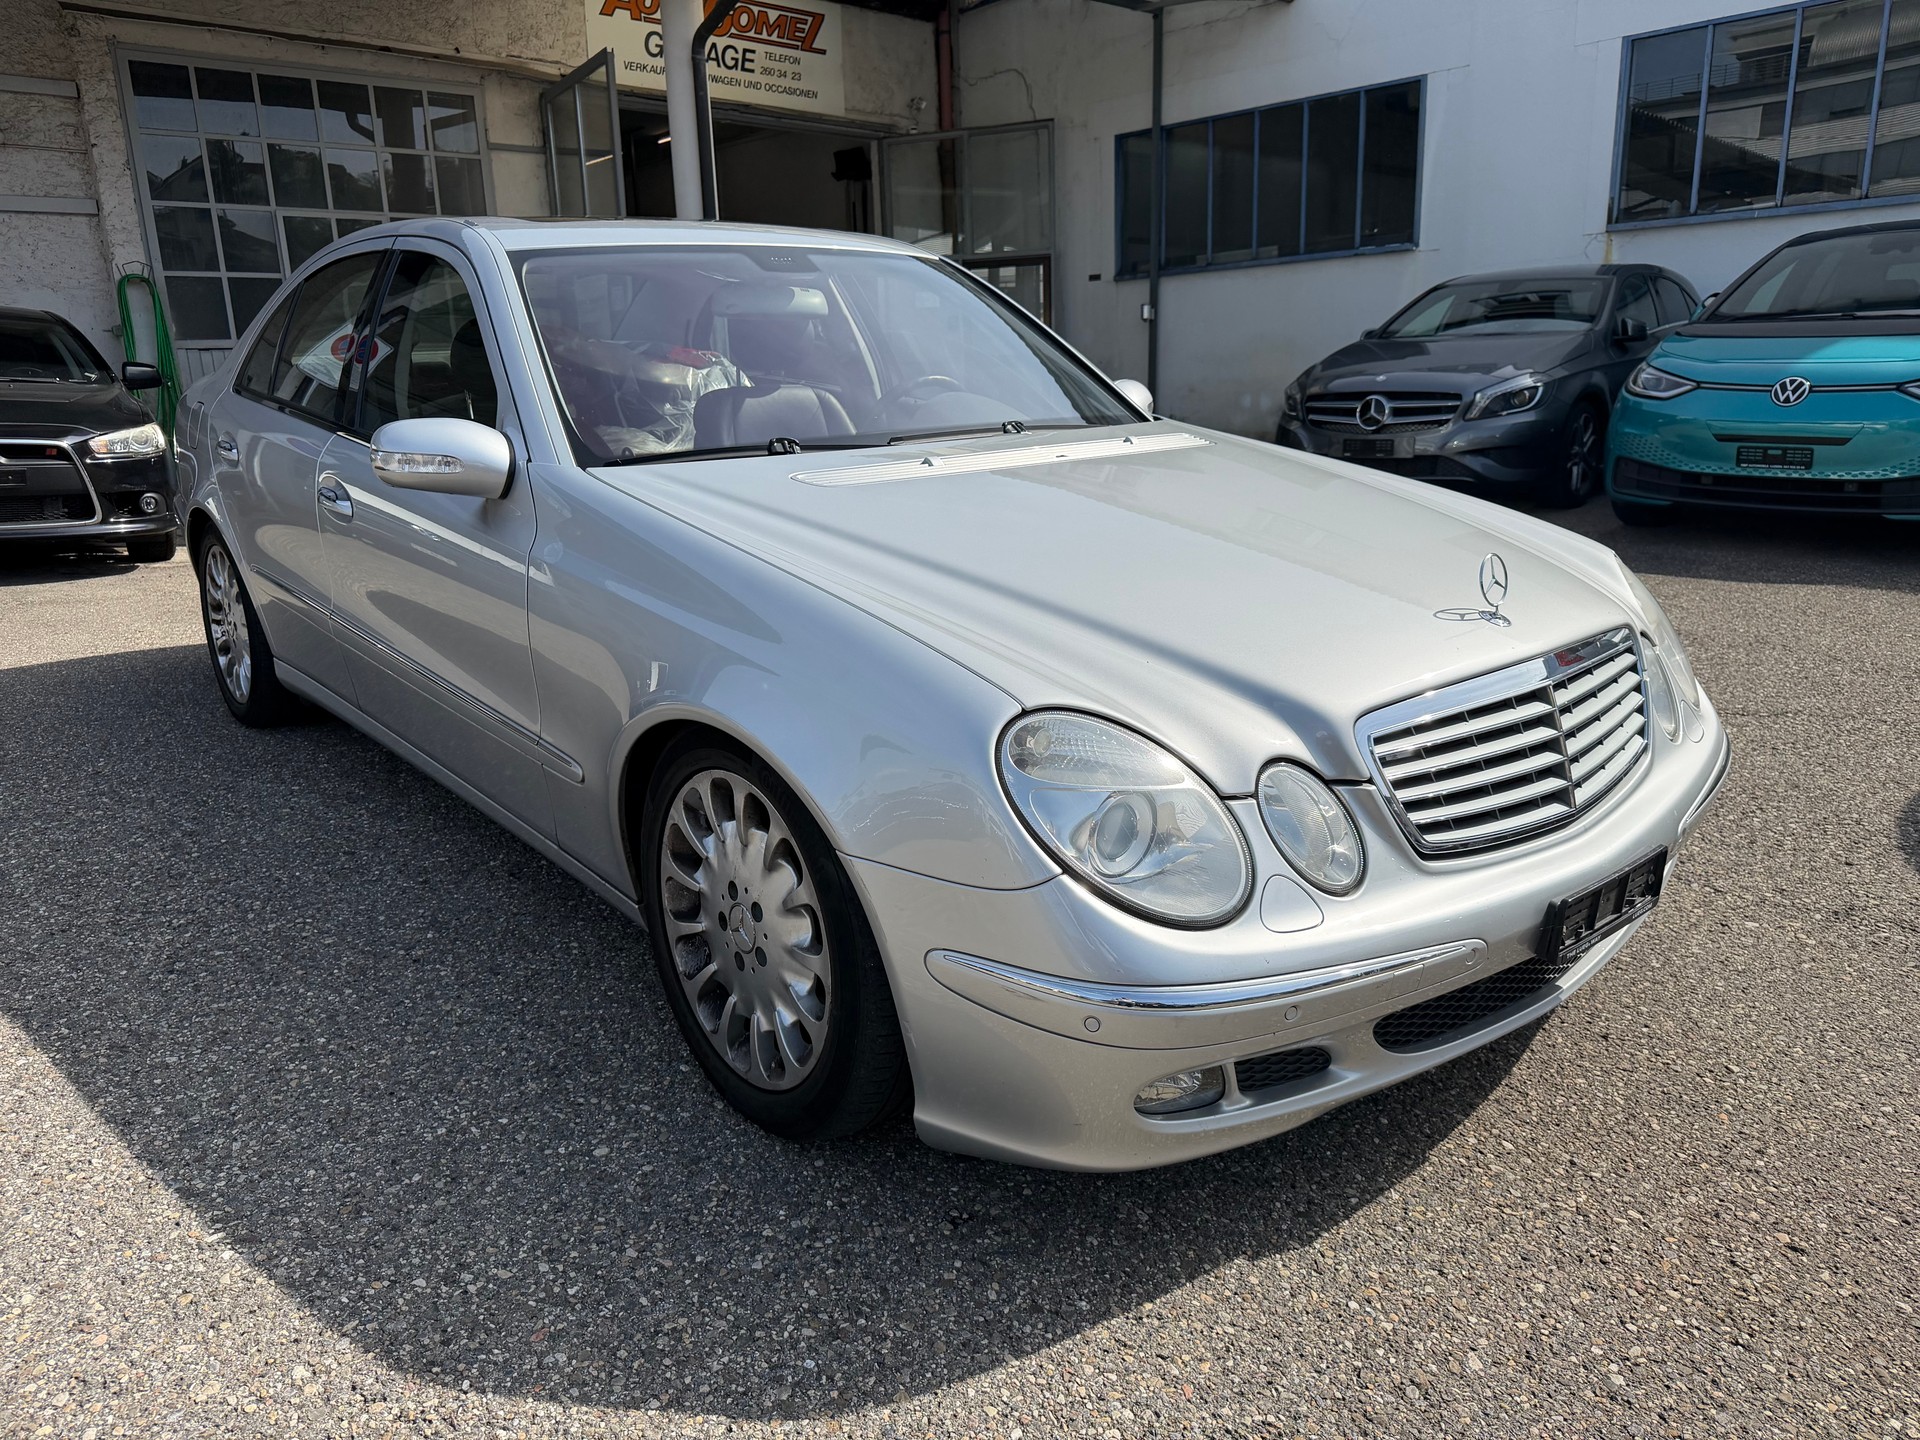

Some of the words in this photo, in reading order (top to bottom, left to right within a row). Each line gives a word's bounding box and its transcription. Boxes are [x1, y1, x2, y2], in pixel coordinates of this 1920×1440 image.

[644, 31, 756, 74] GAGE
[764, 51, 801, 65] TELEFON
[760, 66, 775, 77] 260
[776, 69, 787, 79] 34
[791, 71, 802, 82] 23
[708, 74, 742, 87] WAGEN
[743, 80, 762, 91] UND
[764, 82, 818, 99] OCCASIONEN
